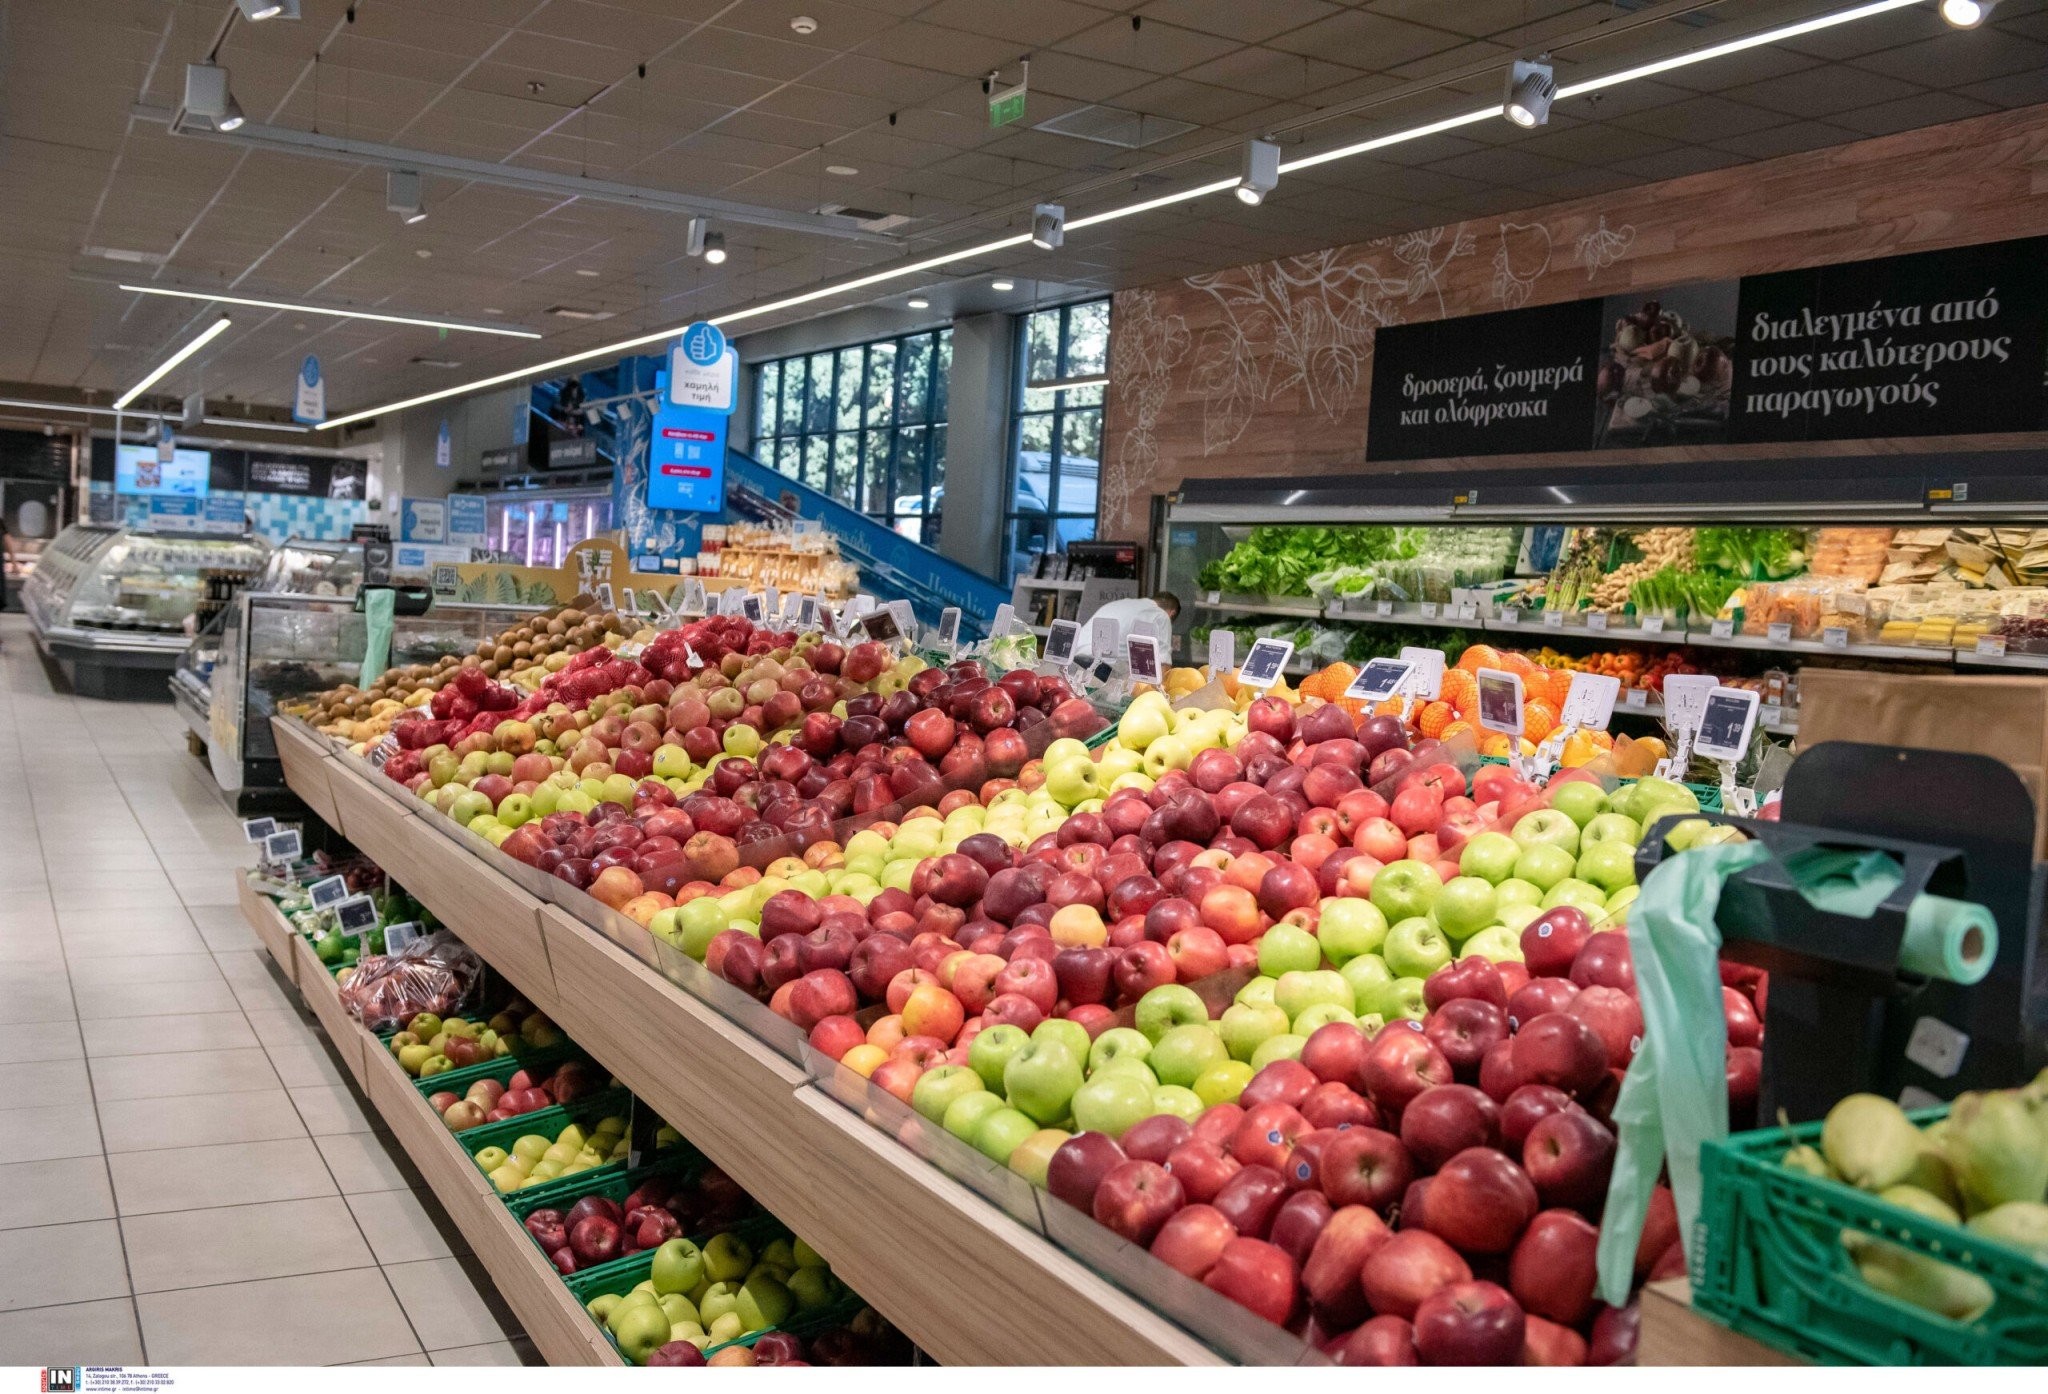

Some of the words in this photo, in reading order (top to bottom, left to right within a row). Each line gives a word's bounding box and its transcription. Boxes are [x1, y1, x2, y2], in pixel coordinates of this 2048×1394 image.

[1751, 299, 1921, 342] διαλεγμένα
[1930, 287, 1999, 324] από
[1750, 353, 1812, 378] τους
[1819, 336, 2011, 372] καλύτερους
[684, 381, 719, 394] χαμηλή
[697, 392, 711, 403] τιμή
[1402, 367, 1488, 402] δροσερά,
[1494, 356, 1584, 392] ζουμερά
[1746, 373, 1940, 420] παραγωγούς
[1400, 408, 1429, 426] και
[1434, 398, 1548, 427] ολόφρεσκα
